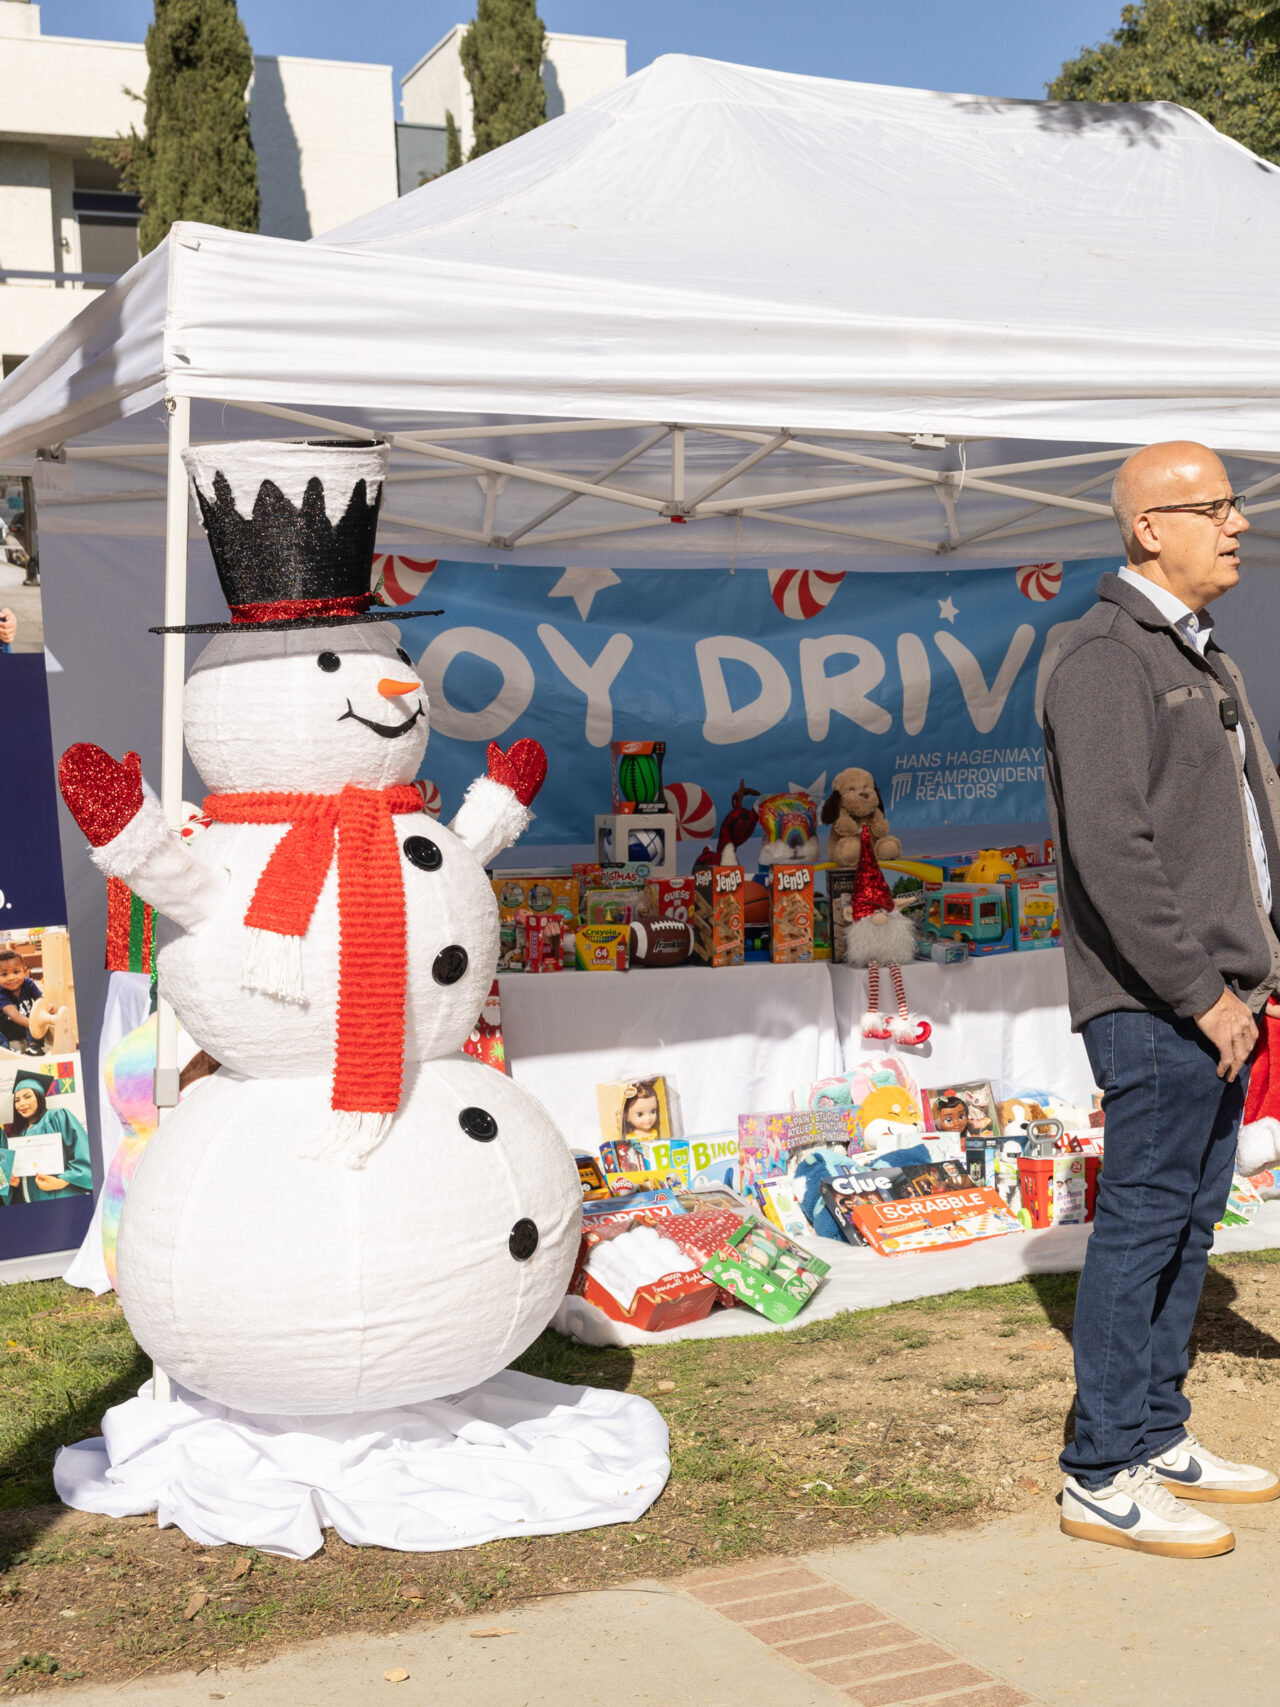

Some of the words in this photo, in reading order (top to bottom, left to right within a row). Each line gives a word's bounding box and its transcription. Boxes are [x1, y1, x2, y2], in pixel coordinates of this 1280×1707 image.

[384, 621, 634, 748] OY
[894, 752, 942, 770] HANS
[945, 747, 1043, 766] HAGENMAY
[916, 766, 1046, 786] TEAMPROVIDENT
[715, 869, 742, 893] Jenga
[777, 869, 811, 891] Jenga
[664, 890, 691, 902] GUESS
[585, 928, 619, 938] Crayola
[594, 947, 608, 958] 64
[653, 939, 686, 953] Franklin
[793, 1113, 813, 1126] PAINT
[815, 1111, 840, 1121] STUDIO
[788, 1123, 814, 1137] ATELIER
[787, 1133, 814, 1149] ESTUDIO
[691, 1139, 740, 1172] BING
[832, 1175, 892, 1195] Clue
[882, 1192, 985, 1219] SCRABBLE
